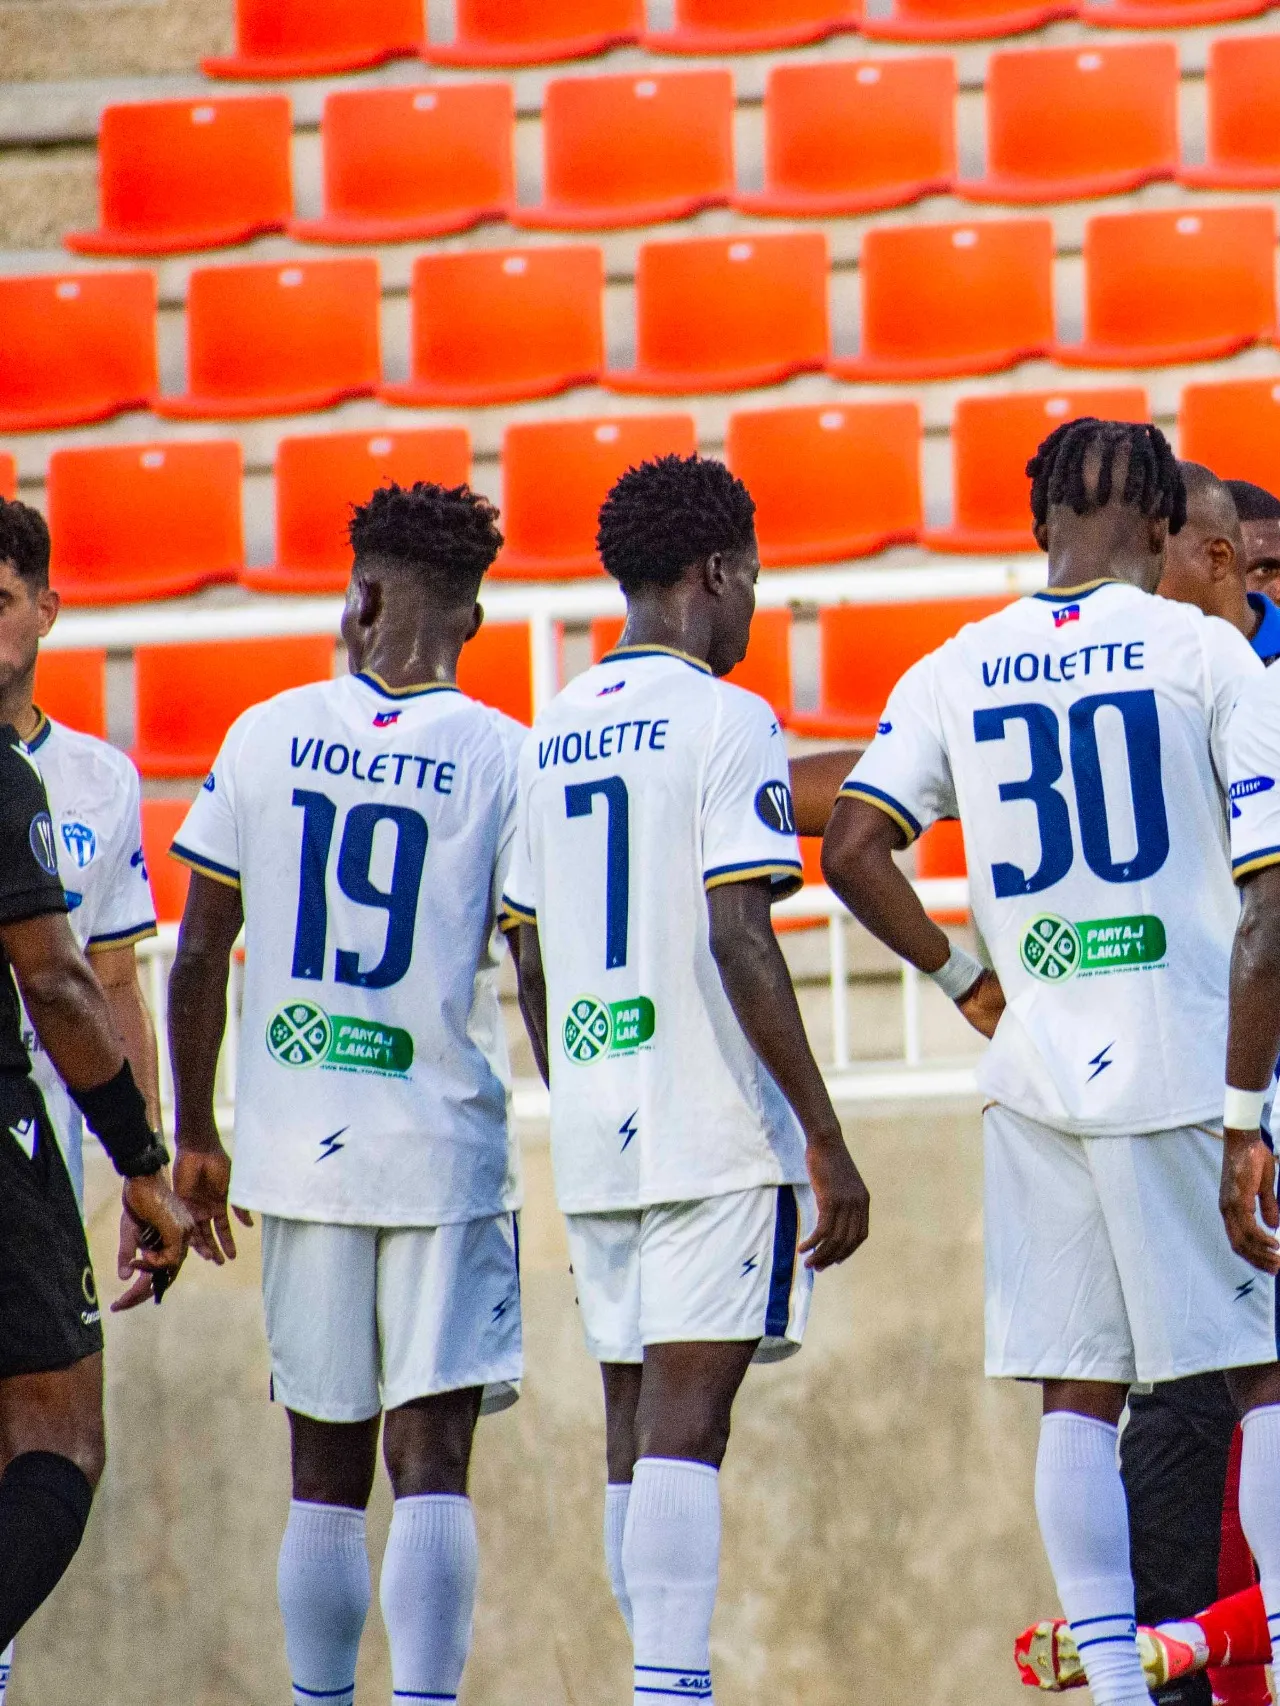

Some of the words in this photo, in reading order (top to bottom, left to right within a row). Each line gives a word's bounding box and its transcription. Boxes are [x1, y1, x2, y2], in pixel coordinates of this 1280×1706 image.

[982, 641, 1145, 688] VIOLETTE
[291, 737, 456, 795] VIOLETTE
[538, 719, 669, 769] VIOLETTE
[973, 688, 1170, 899] 30
[290, 787, 429, 991] 19
[564, 775, 630, 970] 7
[1086, 924, 1144, 943] PARYAJ
[1087, 942, 1131, 960] LAKAY
[335, 1042, 381, 1060] LAKAY
